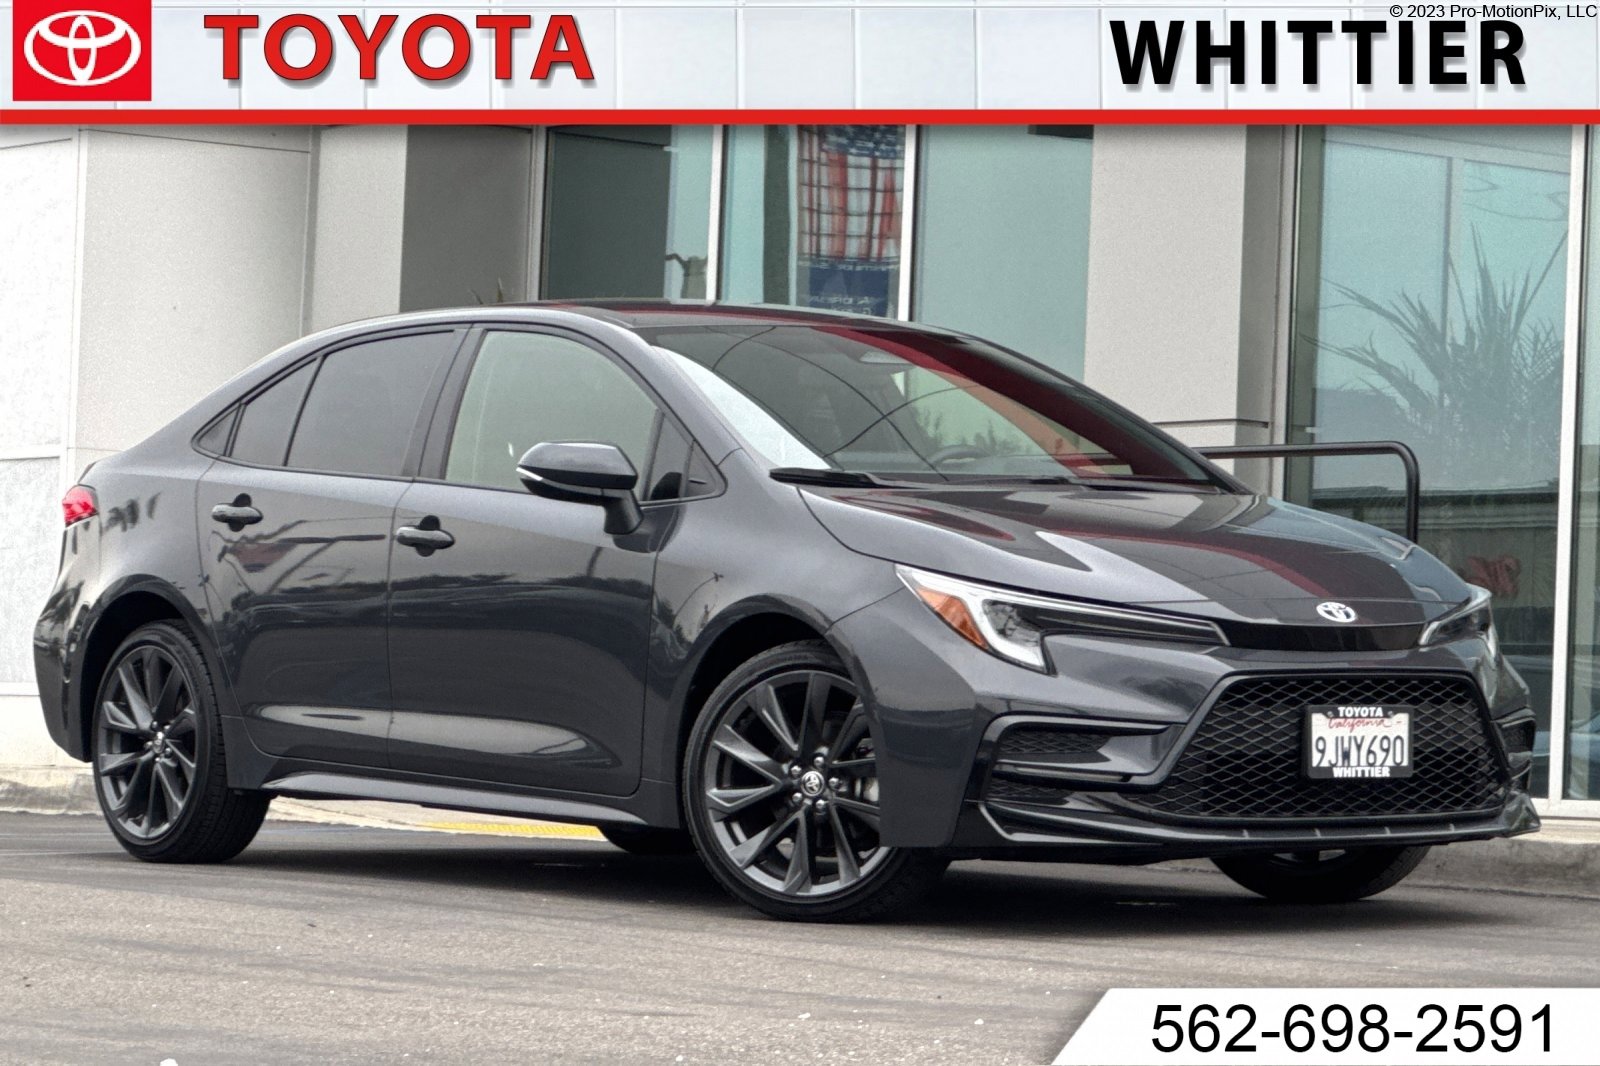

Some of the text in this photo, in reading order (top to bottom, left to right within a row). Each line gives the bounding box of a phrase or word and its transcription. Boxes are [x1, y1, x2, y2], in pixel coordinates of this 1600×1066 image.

[1338, 706, 1384, 717] TOYOTA
[1328, 717, 1391, 733] California
[1315, 735, 1404, 766] 9JWY690
[1332, 766, 1391, 778] WHITTIER
